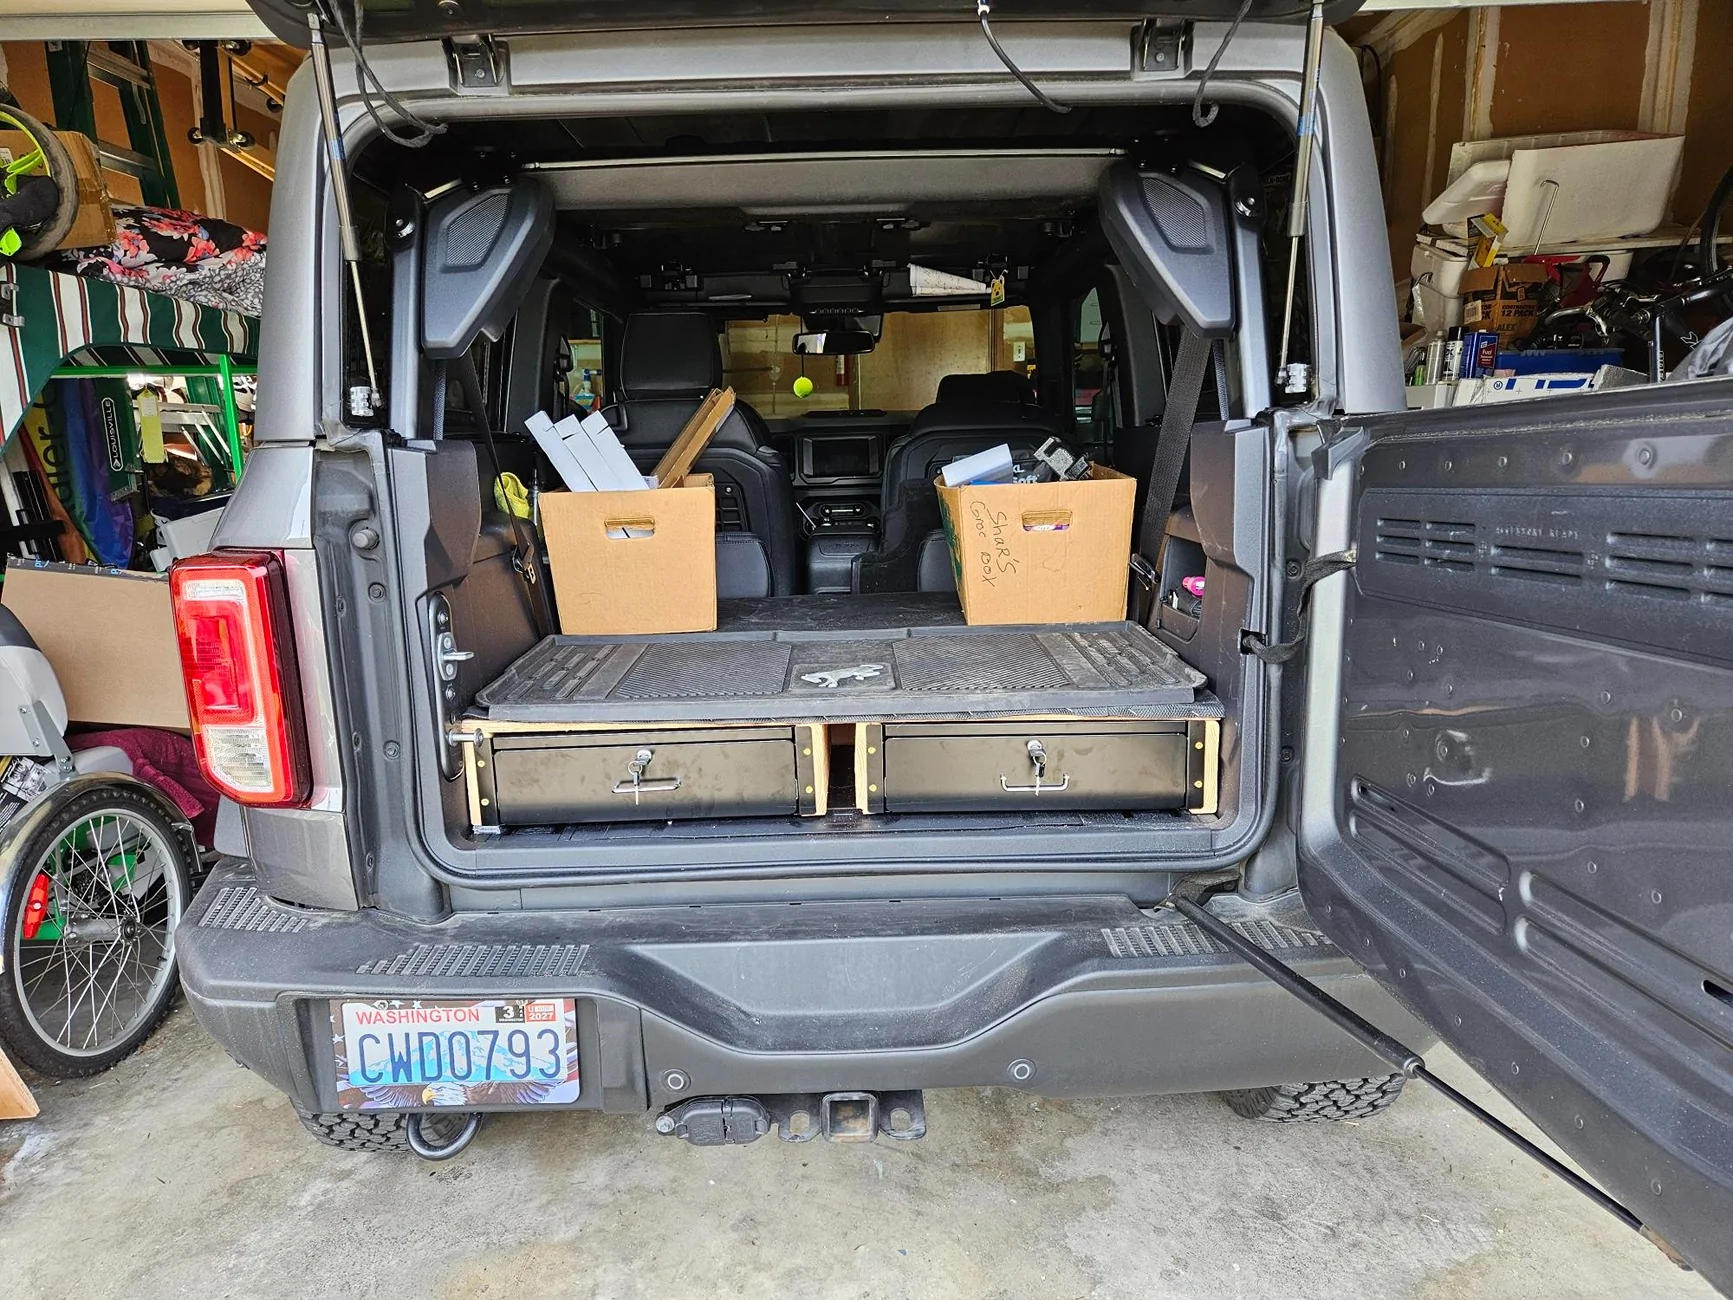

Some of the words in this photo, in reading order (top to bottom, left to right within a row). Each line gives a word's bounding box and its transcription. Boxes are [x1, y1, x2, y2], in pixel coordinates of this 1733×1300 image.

[1501, 309, 1512, 317] 12
[1513, 309, 1534, 317] PACK
[104, 399, 119, 460] LOUISVILLE
[355, 1008, 480, 1025] WASHINGTON
[502, 1005, 515, 1019] 3
[529, 1012, 553, 1021] 2027
[358, 1028, 561, 1083] CWD0793
